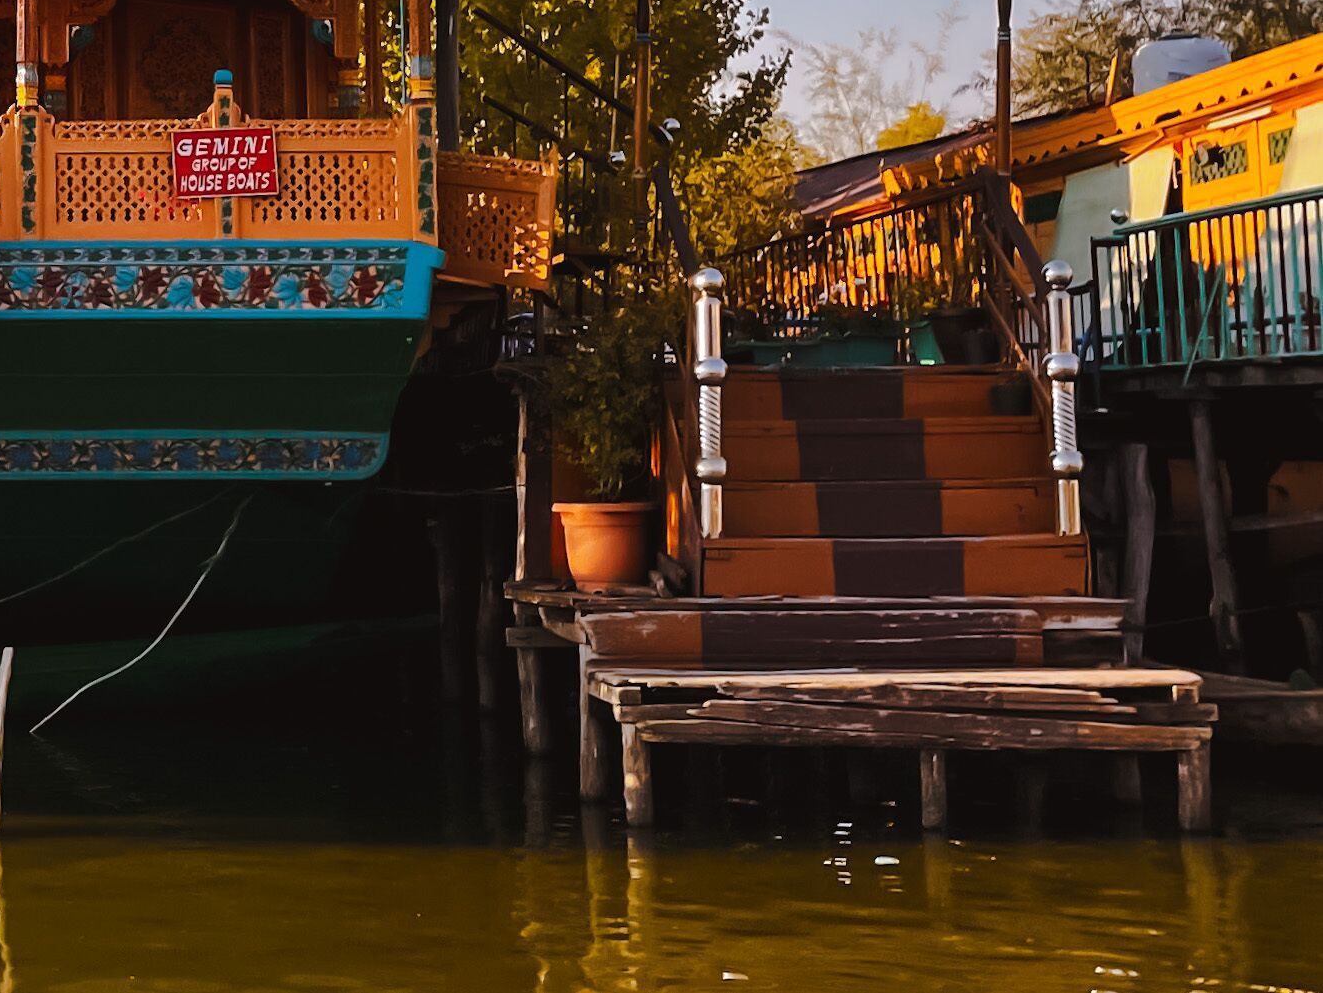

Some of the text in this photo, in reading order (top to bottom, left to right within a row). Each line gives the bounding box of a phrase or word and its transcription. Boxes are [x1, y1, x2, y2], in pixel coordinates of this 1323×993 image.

[177, 135, 271, 157] GEMINI
[192, 157, 257, 172] GROUP OF
[180, 172, 270, 192] HOUSE BOATS
